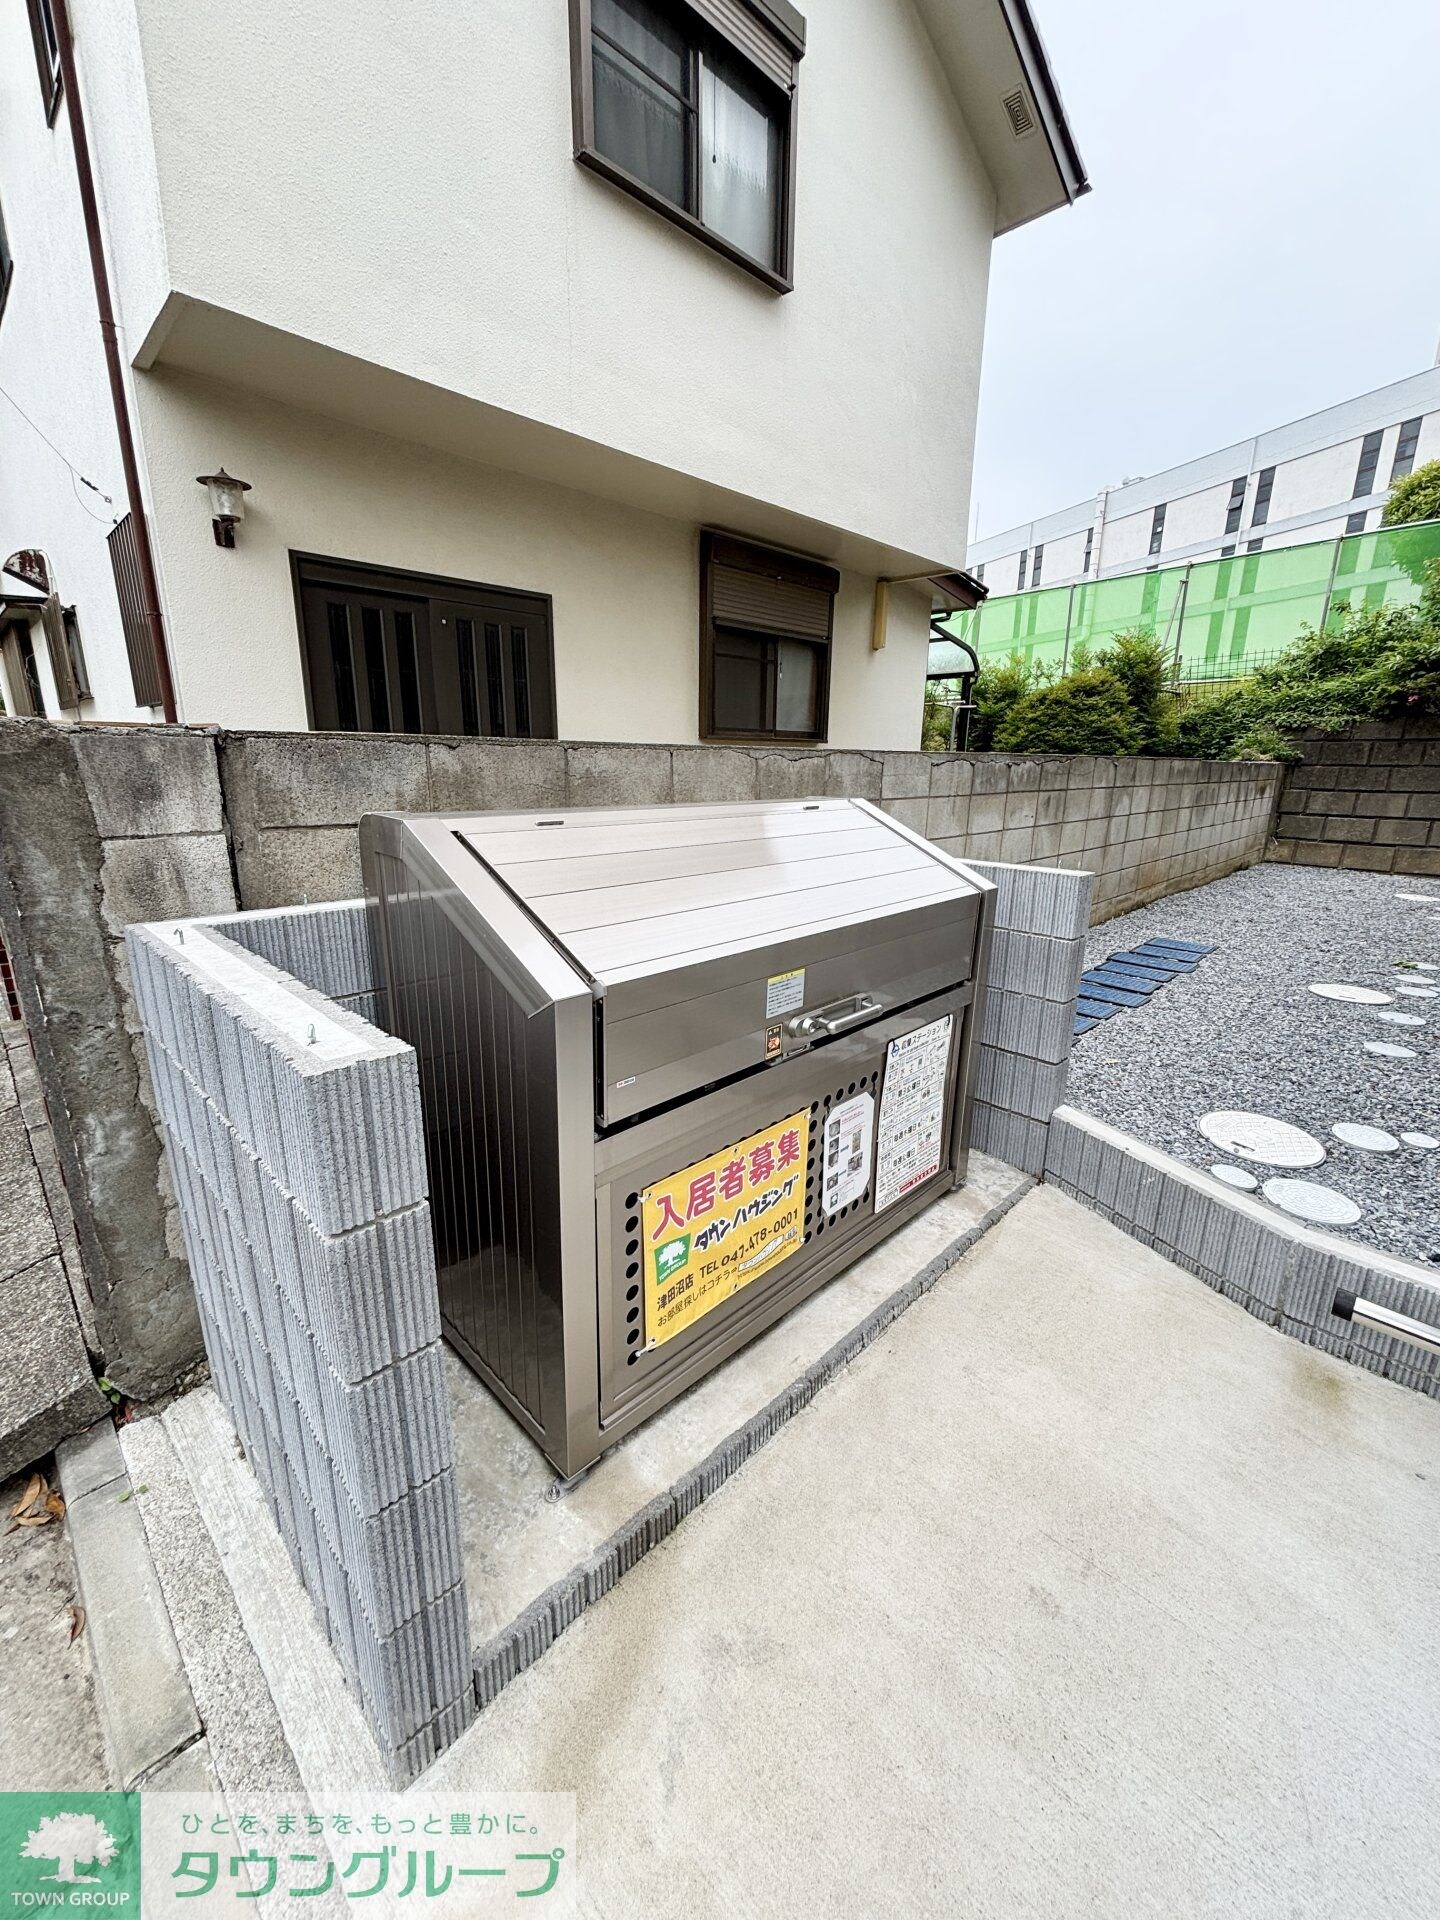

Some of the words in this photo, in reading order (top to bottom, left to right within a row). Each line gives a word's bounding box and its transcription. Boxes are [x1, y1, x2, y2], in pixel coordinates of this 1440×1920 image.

[652, 1129, 800, 1240] 入居者募集
[694, 1174, 799, 1250] タウンハウジング
[657, 1273, 694, 1311] 津田沼店
[700, 1260, 719, 1278] TEL
[721, 1208, 798, 1266] 047-478-0001
